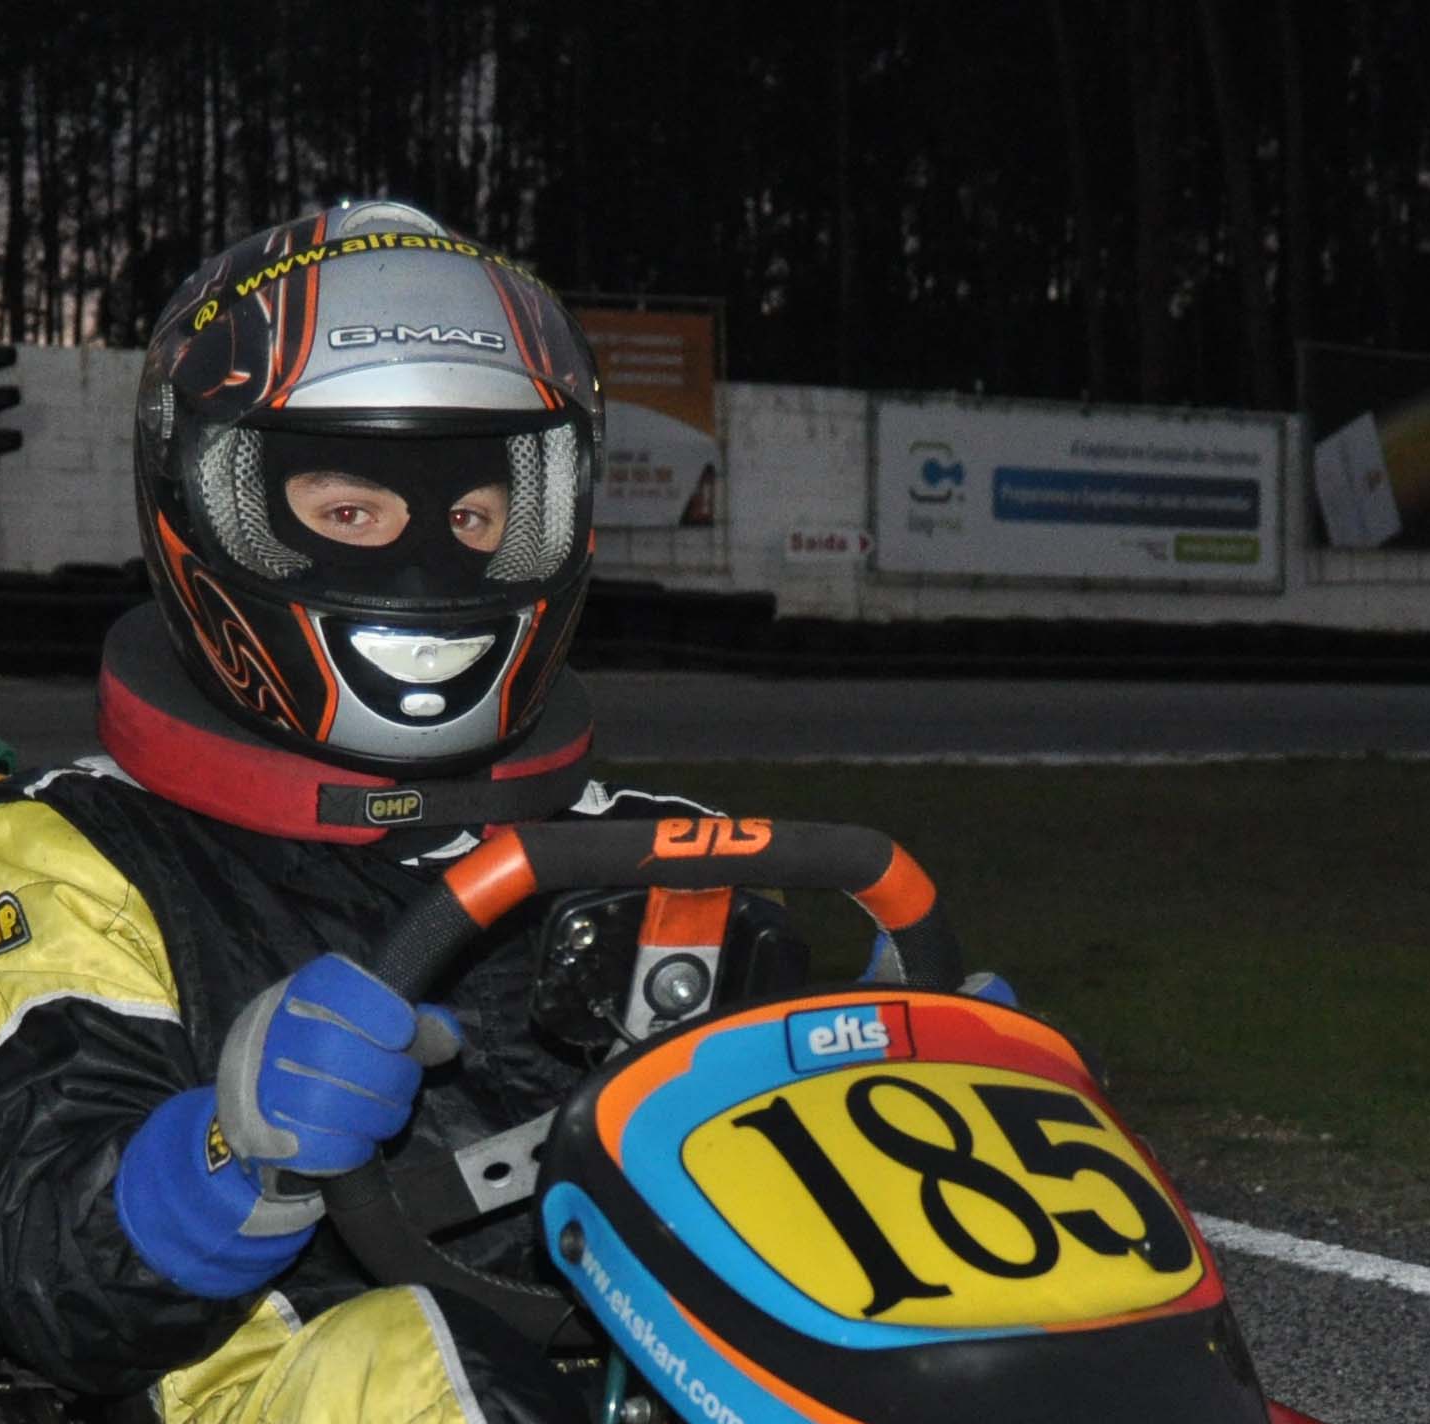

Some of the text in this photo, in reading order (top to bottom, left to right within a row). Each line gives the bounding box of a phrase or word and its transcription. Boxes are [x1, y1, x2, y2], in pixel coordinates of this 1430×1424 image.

[328, 324, 507, 351] G-MAC
[371, 795, 418, 817] OMP
[731, 1073, 1197, 1321] 185
